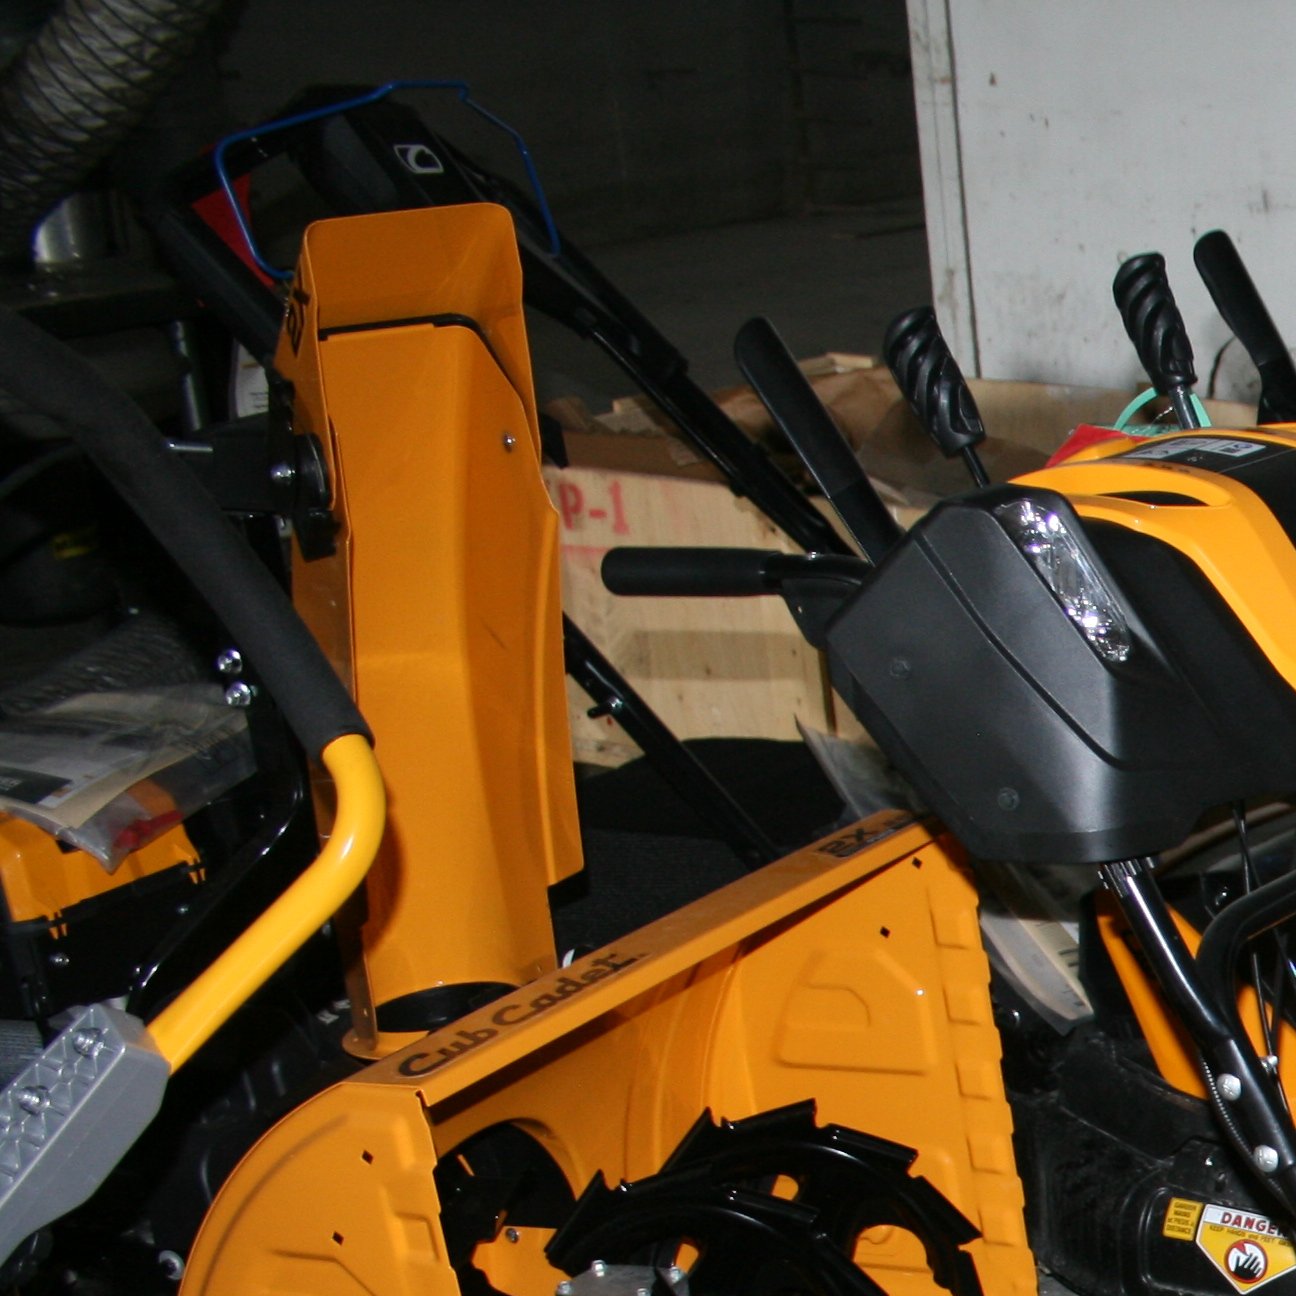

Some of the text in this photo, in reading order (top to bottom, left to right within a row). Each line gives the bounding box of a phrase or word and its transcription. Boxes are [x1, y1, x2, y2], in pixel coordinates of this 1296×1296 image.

[398, 953, 639, 1077] Cub Cadet
[1221, 1211, 1284, 1238] DANGE
